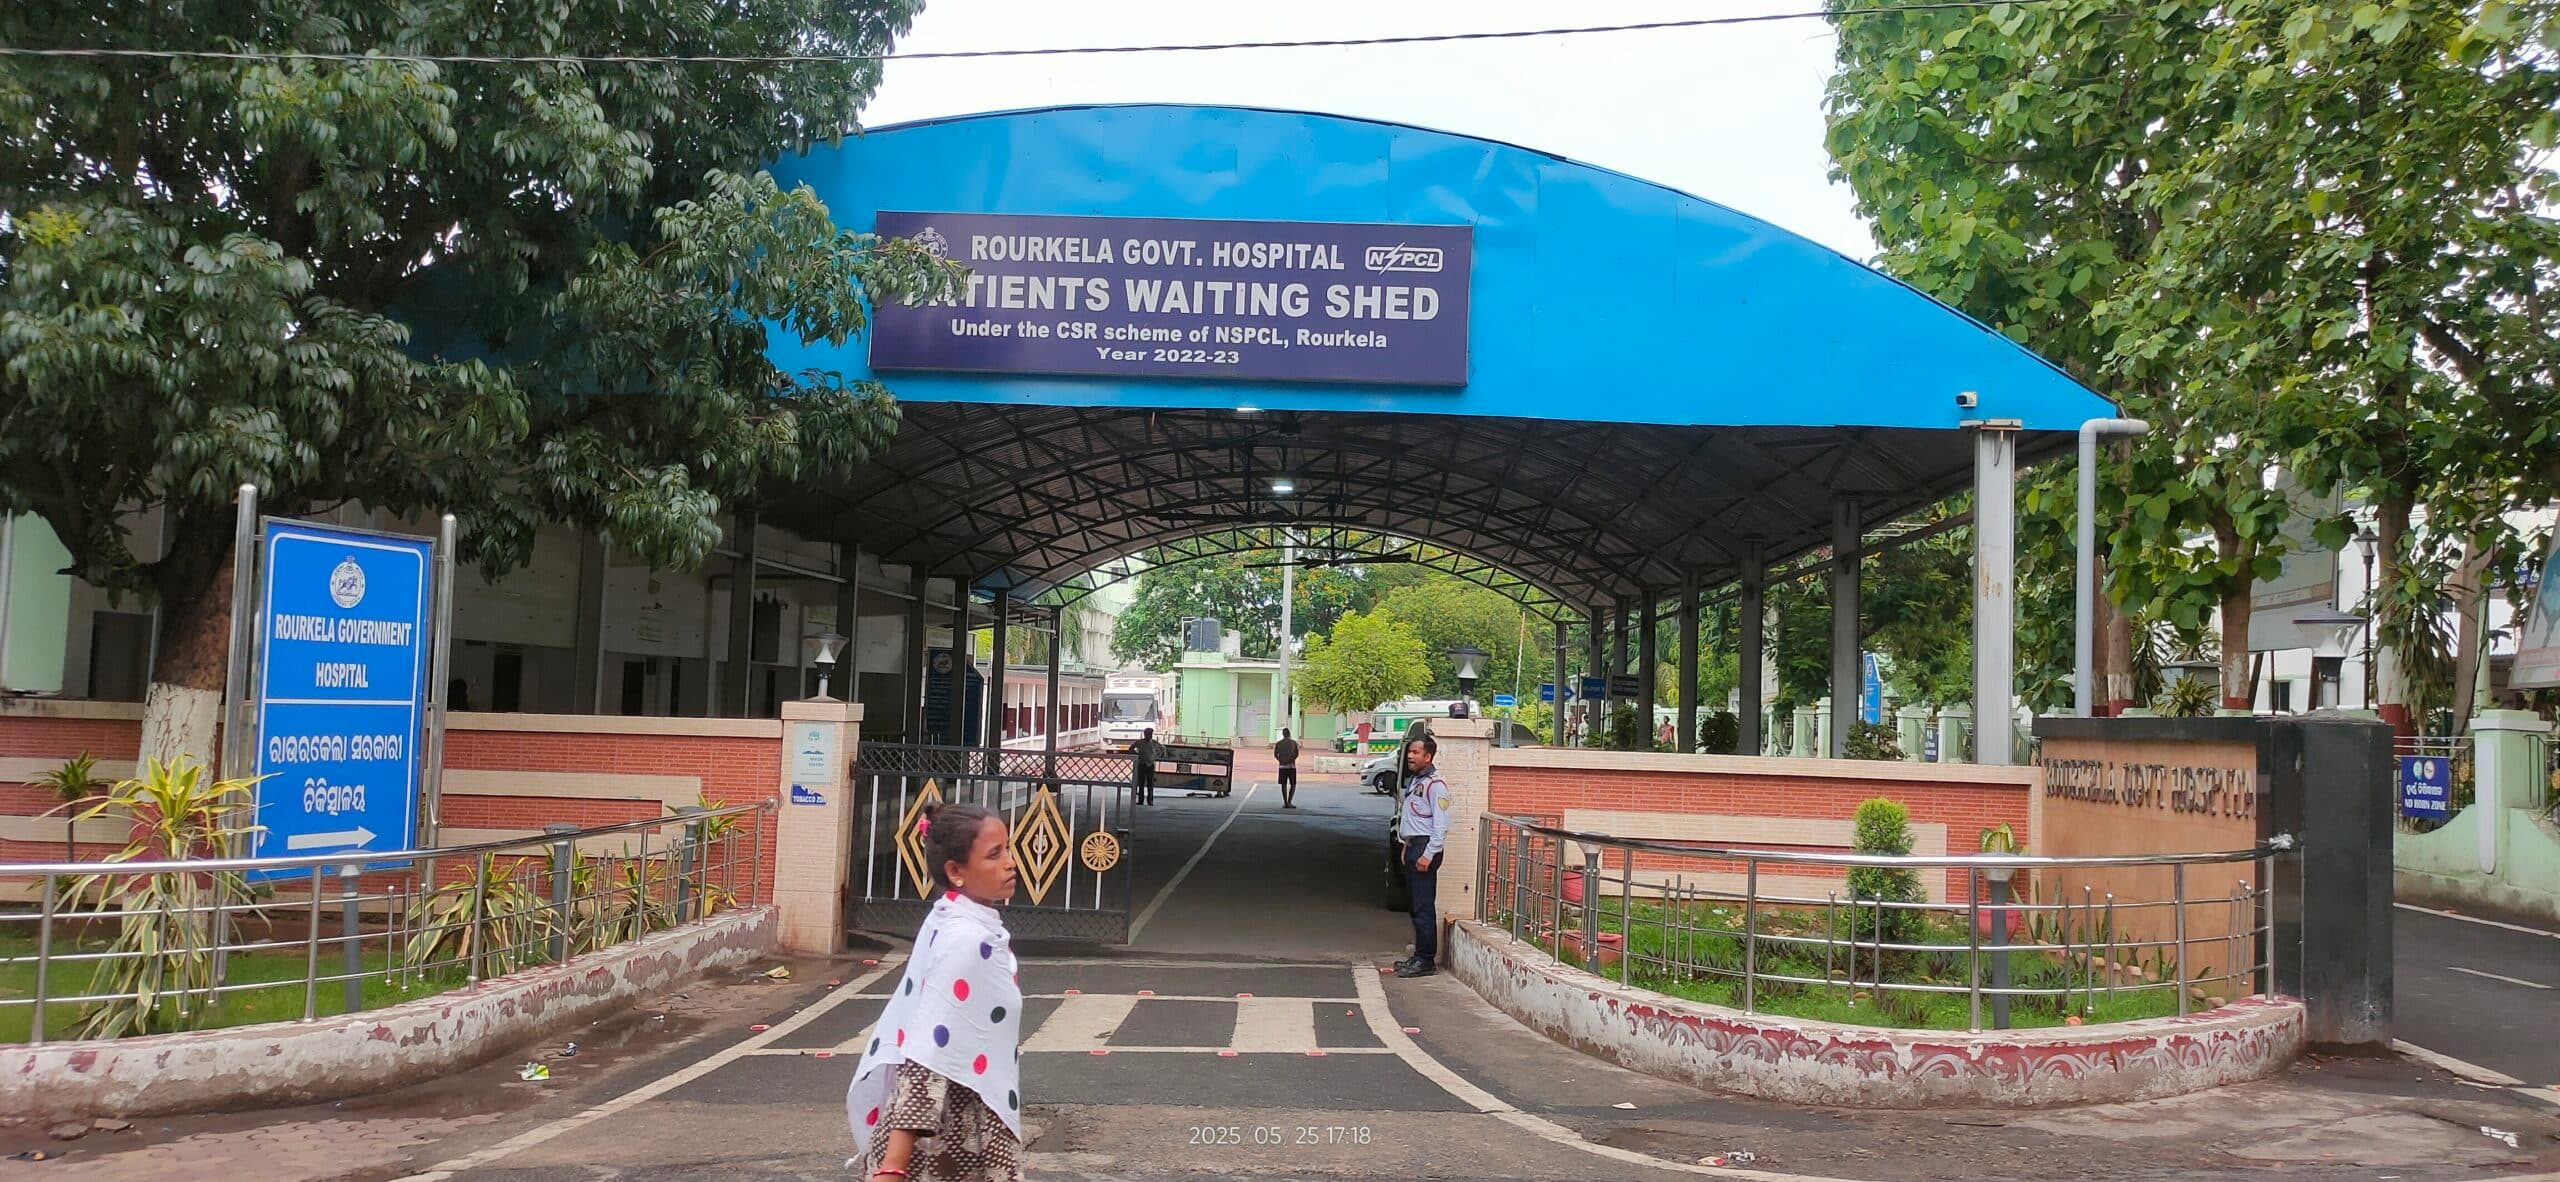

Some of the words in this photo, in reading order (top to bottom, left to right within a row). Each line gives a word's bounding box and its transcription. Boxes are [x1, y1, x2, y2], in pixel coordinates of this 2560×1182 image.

[971, 235, 1114, 264] ROURKELA
[1122, 238, 1203, 266] GOVT.
[1212, 241, 1345, 270] HOSPITAL
[1125, 279, 1310, 318] WAITING
[1325, 285, 1439, 320] SHED
[951, 318, 1012, 337] Under
[1017, 320, 1050, 338] the
[1056, 322, 1098, 340] CSR
[1104, 325, 1182, 342] scheme
[1188, 326, 1210, 343] of
[1215, 327, 1289, 349] NSPCL,
[1296, 328, 1387, 348] Rourkela
[1096, 346, 1148, 362] Year
[1153, 348, 1240, 364] 2022-23
[275, 613, 336, 642] ROURKELA
[338, 618, 412, 646] GOVERNMENT
[315, 662, 369, 688] HOSPITAL
[351, 734, 403, 762] ସରକାରୀ
[2404, 798, 2414, 808] NO
[2431, 800, 2446, 810] ZONE
